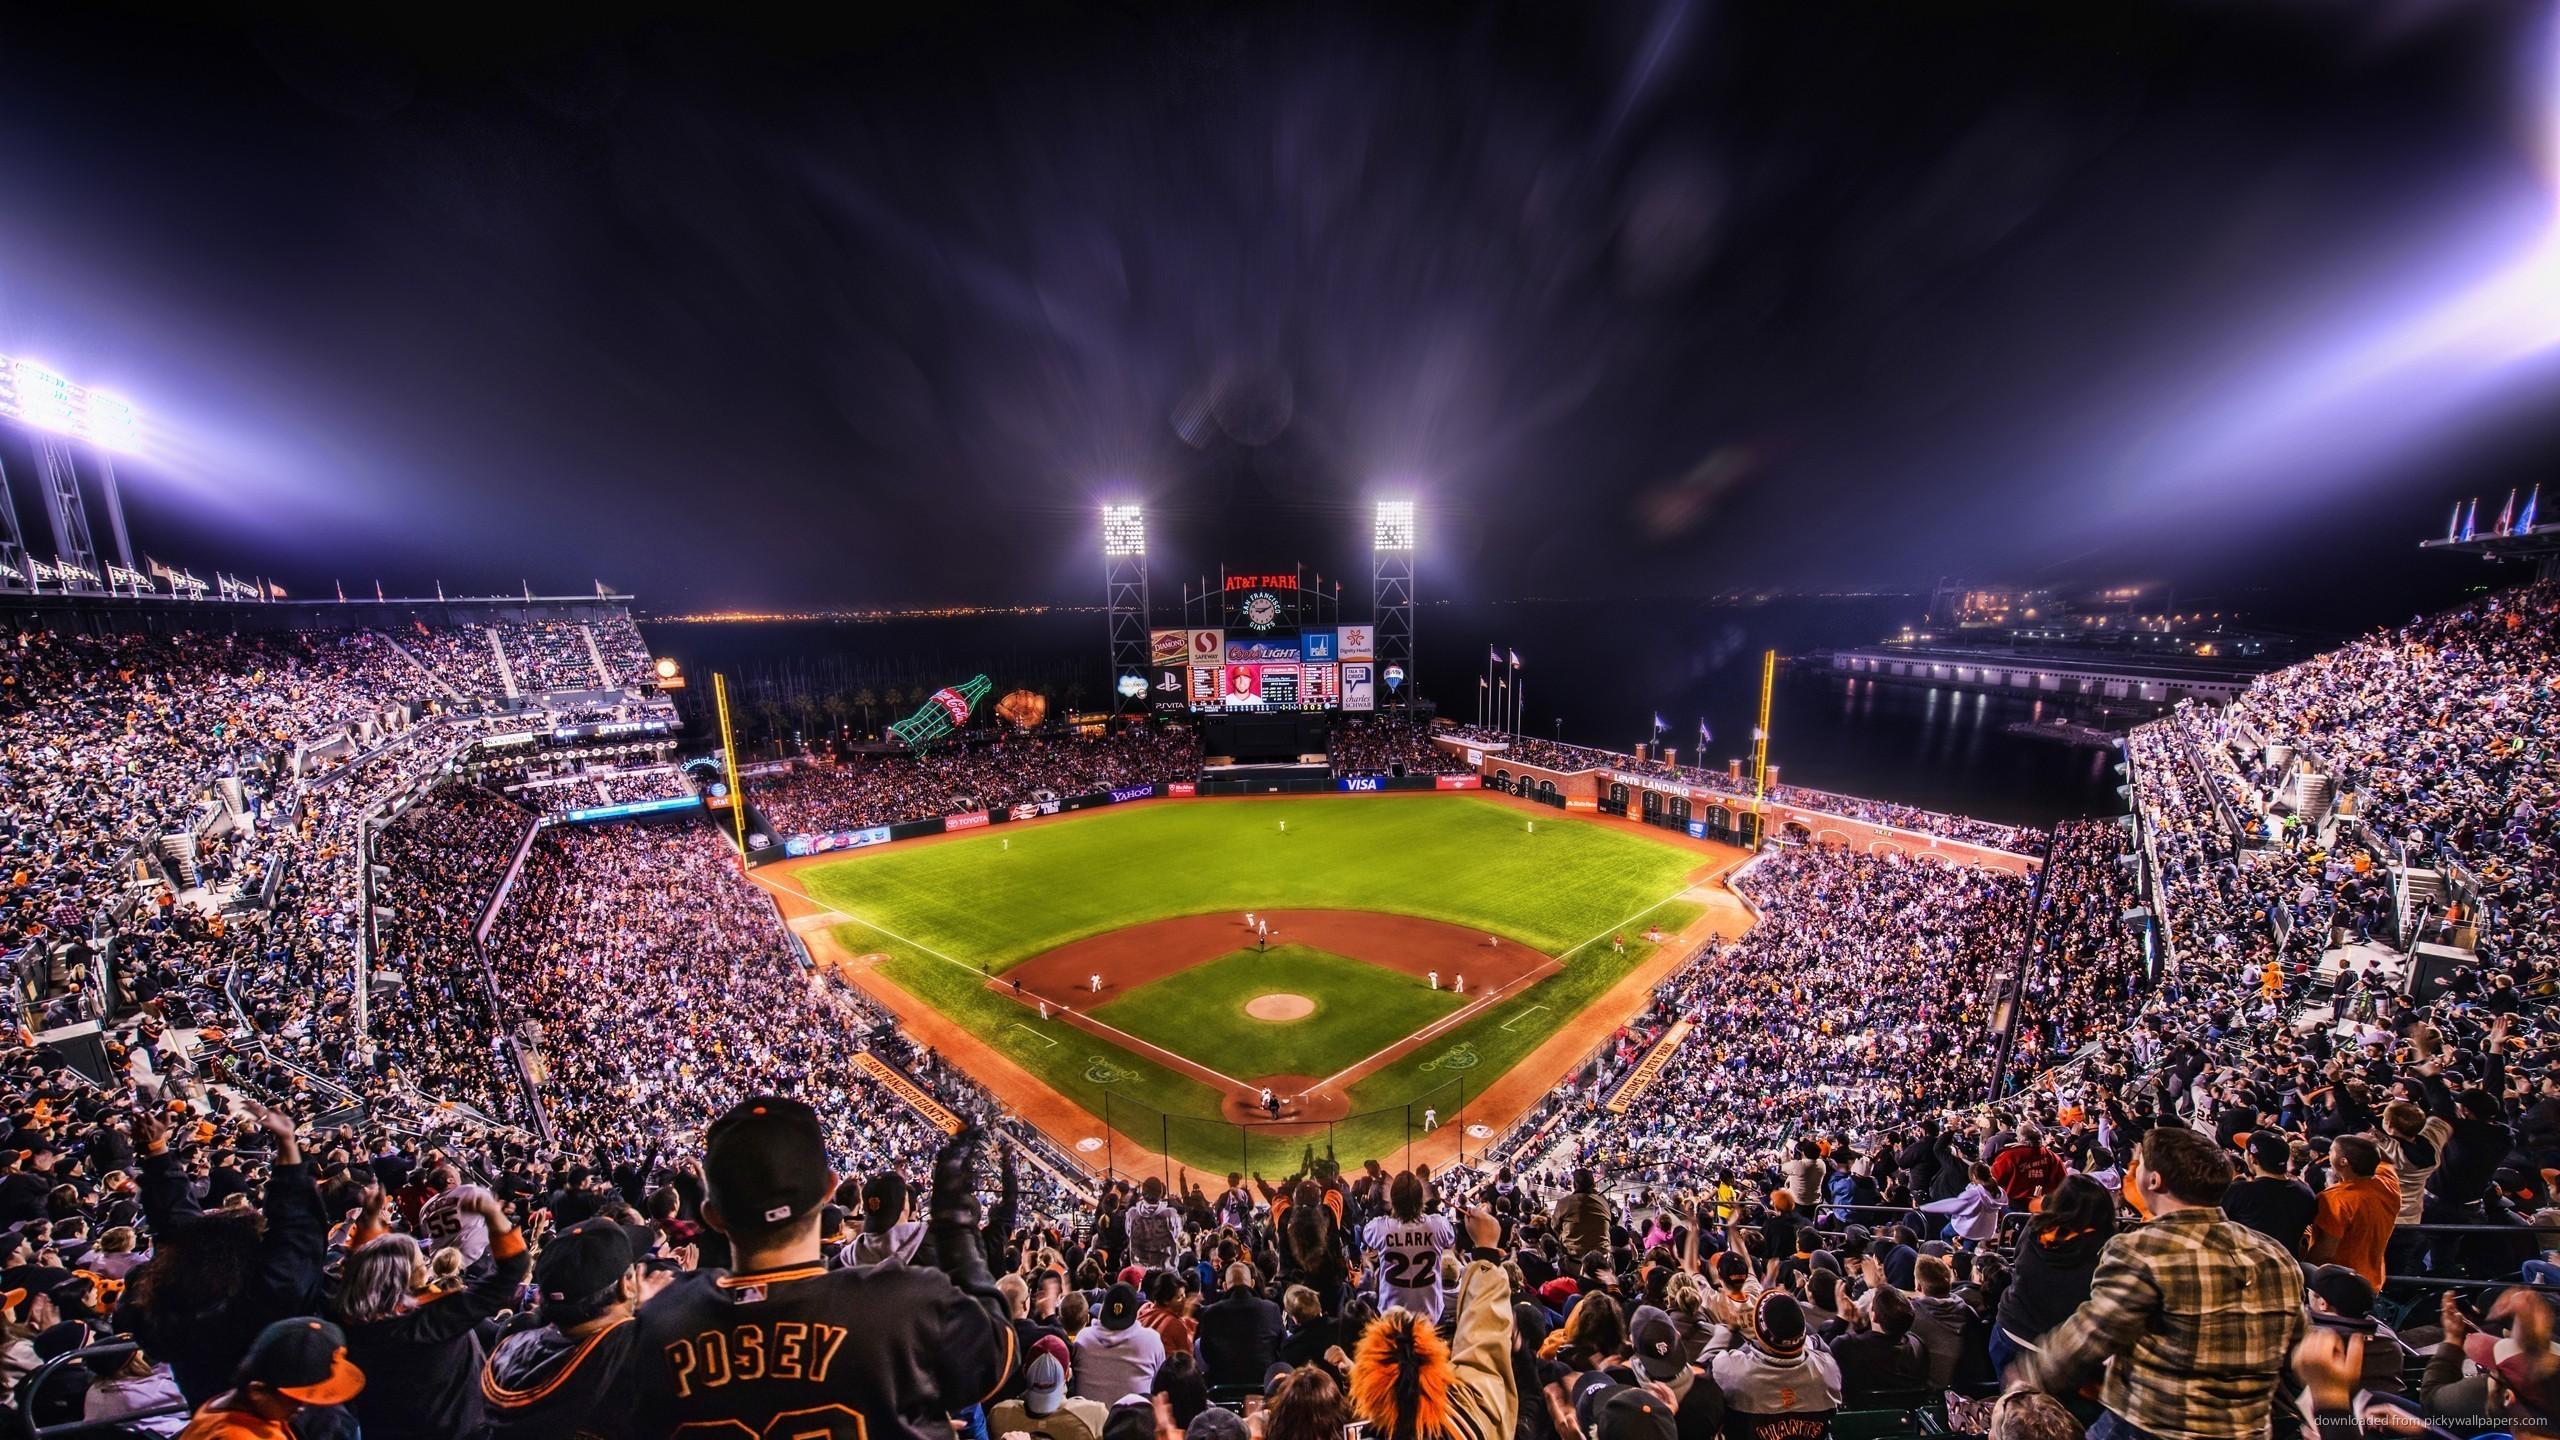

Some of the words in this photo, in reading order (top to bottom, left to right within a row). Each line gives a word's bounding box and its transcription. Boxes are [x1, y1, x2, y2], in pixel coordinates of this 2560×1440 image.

[1225, 575, 1258, 592] AT&T
[1261, 575, 1298, 590] PARK
[1242, 600, 1251, 615] SAN
[1249, 592, 1281, 614] FRANCISCO
[1249, 621, 1276, 631] GIANTS
[1154, 638, 1185, 652] DIAMOND
[1262, 648, 1298, 659] LIGHT
[680, 756, 722, 773] Ghirardelli
[1346, 779, 1377, 790] VISA
[1642, 780, 1689, 797] LANDING
[1112, 786, 1153, 802] YAHOO!
[958, 814, 988, 826] TOYOTA
[1660, 1042, 1676, 1057] PARK
[1646, 1054, 1662, 1074] AT&T
[1641, 1069, 1653, 1079] TO
[864, 1060, 884, 1077] SAN
[879, 1071, 920, 1101] FRANCISCO
[914, 1096, 948, 1122] GIANTS
[1613, 1073, 1646, 1107] WELCOME
[427, 1209, 462, 1239] 55
[1385, 1231, 1434, 1248] CLARK
[1385, 1251, 1437, 1289] 22
[664, 1321, 848, 1398] POSEY
